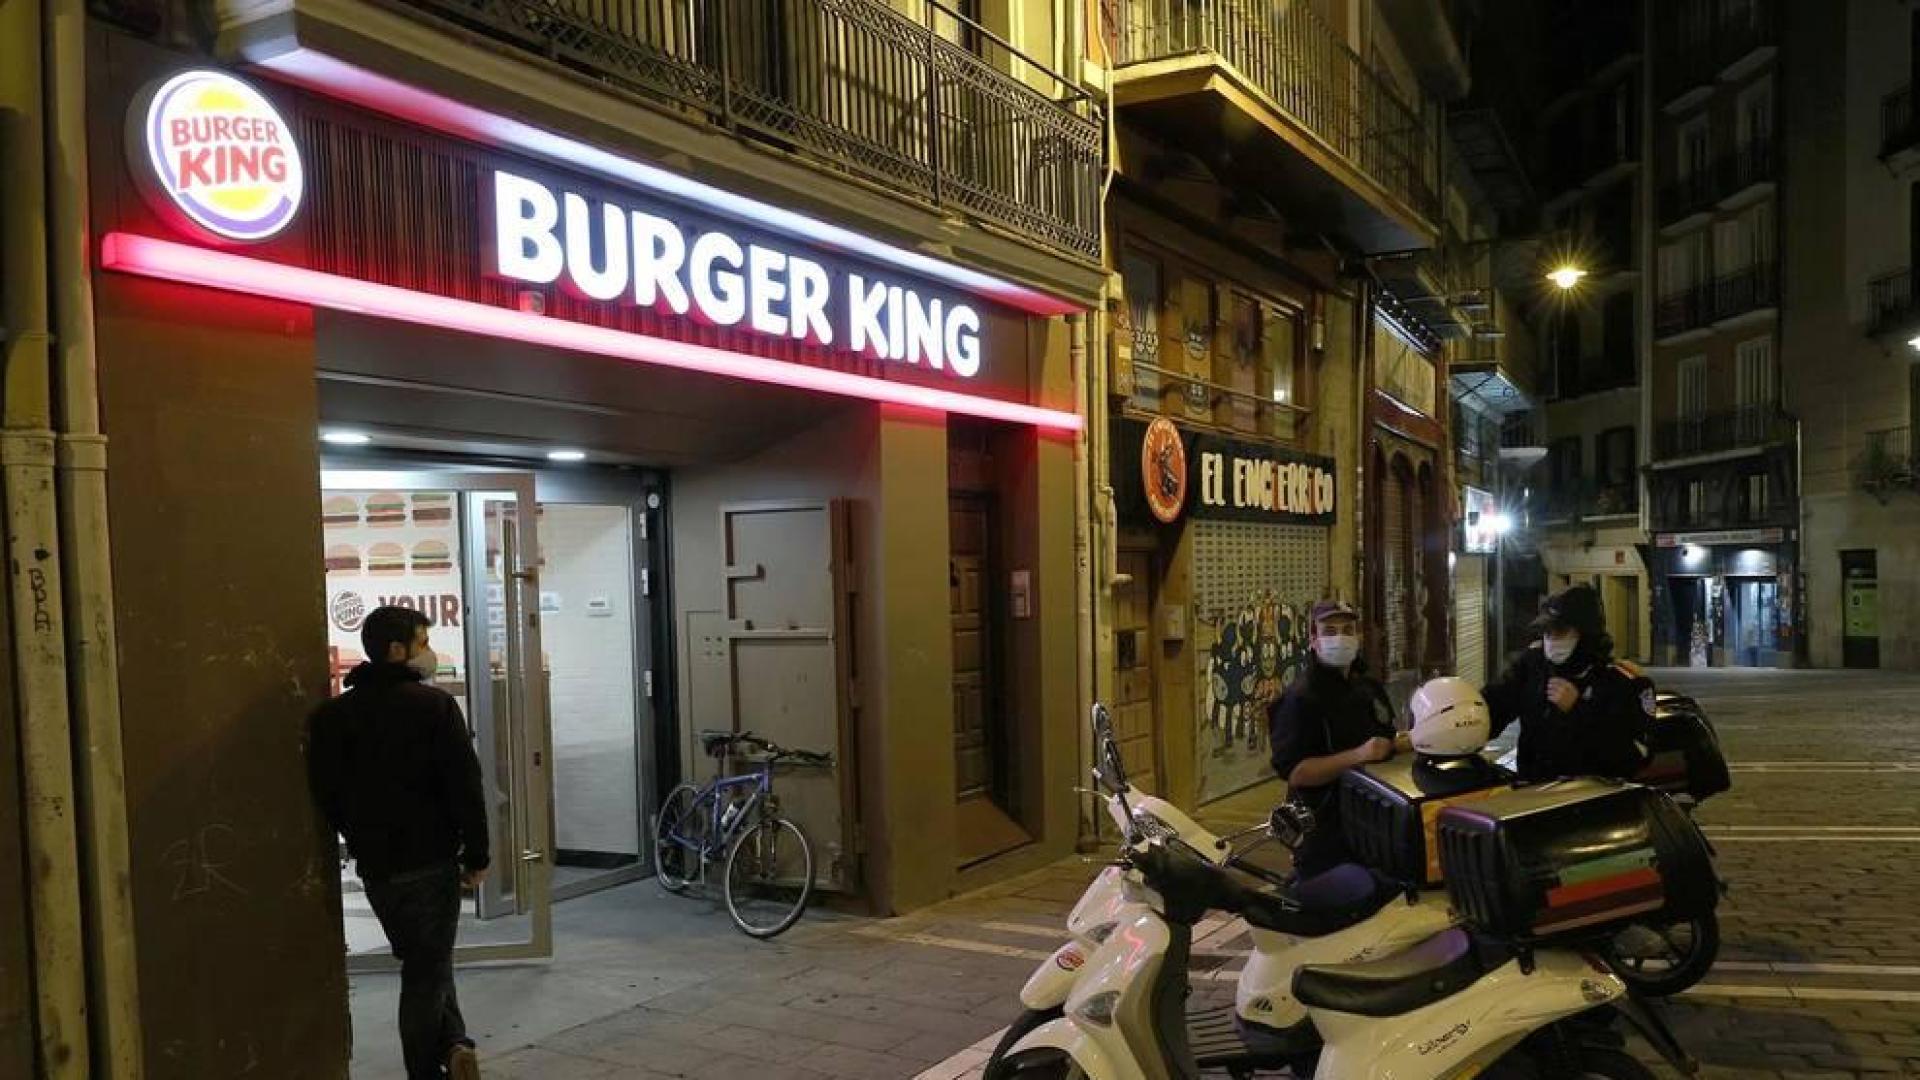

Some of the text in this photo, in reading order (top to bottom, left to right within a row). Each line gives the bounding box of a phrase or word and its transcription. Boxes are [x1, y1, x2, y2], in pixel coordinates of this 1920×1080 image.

[171, 116, 281, 147] BURGER
[179, 145, 288, 190] KING
[494, 170, 981, 378] BURGER KING
[1201, 451, 1226, 506] EL
